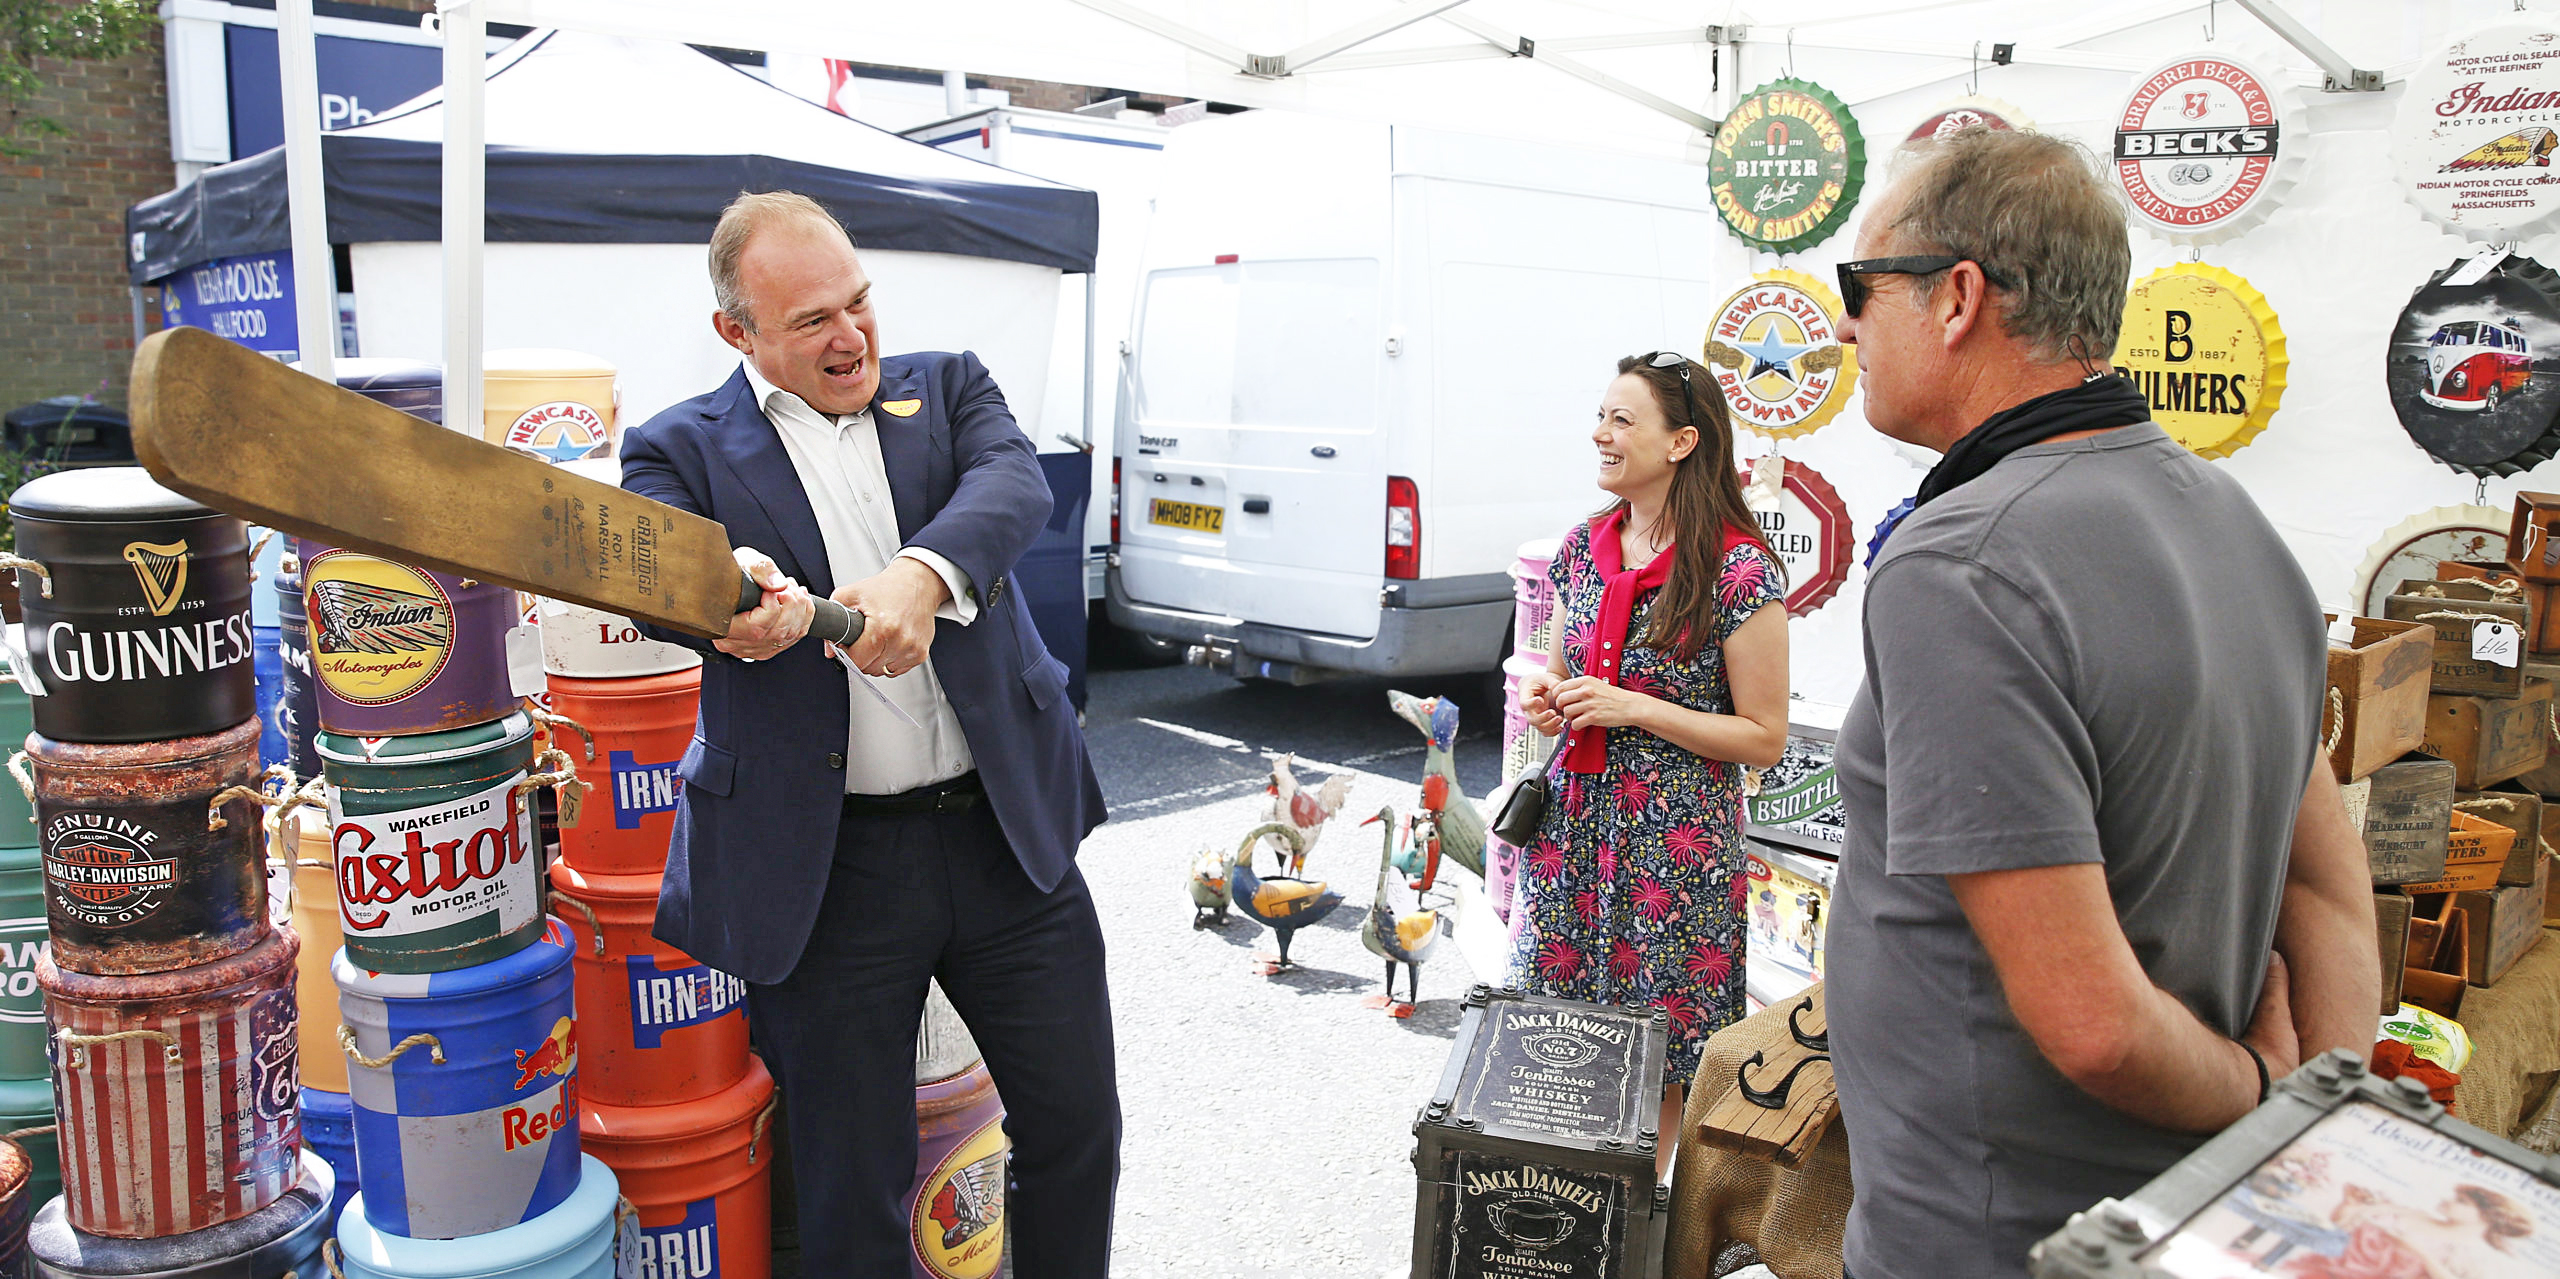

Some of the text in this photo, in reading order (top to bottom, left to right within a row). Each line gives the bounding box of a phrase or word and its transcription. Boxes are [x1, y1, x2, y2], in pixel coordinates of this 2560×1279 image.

[2447, 57, 2480, 67] MOTOR
[2483, 54, 2510, 64] CYCLE
[2513, 53, 2528, 61] OIL
[2466, 62, 2543, 75] AT THE REFINERY
[2124, 63, 2197, 128] BRAUEREI
[2435, 82, 2560, 117] Indian
[321, 93, 384, 130] Ph
[1714, 94, 1844, 159] JOHN SMITH'S
[2123, 127, 2268, 156] BECK'S
[1735, 159, 1818, 178] BITTER
[2417, 181, 2450, 189] INDIAN
[2453, 179, 2490, 188] MOTOR
[2493, 178, 2524, 187] CYCLE
[2459, 189, 2528, 198] SPRINGFIELDS
[1712, 180, 1842, 241] JOHN SMITH'S
[2451, 200, 2535, 209] MASSACHUSETTS
[227, 259, 283, 303] HOUSE
[1718, 292, 1829, 343] NEWCASTLE
[2165, 311, 2193, 362] B
[2130, 349, 2227, 359] ESTD 1887
[1718, 373, 1828, 422] BROWN ALE
[511, 406, 604, 444] NEWCASTLE
[1156, 501, 1222, 530] MH08 FYZ
[598, 503, 609, 583] MARSHALL
[612, 533, 622, 563] ROY
[637, 515, 651, 596] GRADIDGE
[181, 600, 205, 611] 1759
[346, 602, 435, 631] Indian
[1529, 604, 1540, 650] BREWDOG
[47, 608, 253, 682] GUINNESS
[2475, 637, 2508, 655] £16
[323, 656, 424, 678] Motorcycles
[618, 768, 673, 810] IRN
[47, 814, 159, 846] GENUINE
[387, 799, 491, 833] WAKEFIELD
[2368, 821, 2434, 832] MARMALADE
[65, 846, 123, 863] MOTOR
[334, 785, 528, 930] Castrol
[2373, 839, 2427, 851] MERCURY
[2385, 852, 2409, 864] TEA
[47, 860, 171, 884] HARLEY-DAVIDSON
[73, 887, 127, 899] CYCLES
[138, 883, 173, 892] MARK
[411, 879, 508, 916] MOTOR OIL
[56, 895, 161, 924] MOTOR OIL
[637, 974, 697, 1025] IRN
[1506, 1012, 1627, 1044] JACK DANIEL'S
[1564, 1028, 1583, 1038] TIME
[2385, 1023, 2432, 1040] Dettol
[271, 1052, 299, 1106] 66
[1510, 1065, 1596, 1088] Tennessee
[1508, 1085, 1593, 1105] WHISKEY
[1538, 1098, 1550, 1106] AND
[1550, 1100, 1574, 1110] BOTTLED
[502, 1082, 567, 1153] Red
[1490, 1100, 1607, 1123] JACK DANIEL DISTILLERY
[1466, 1165, 1605, 1214] JACK DANIEL'S
[1512, 1190, 1554, 1205] OLD TIME
[1481, 1245, 1573, 1274] Tennessee
[1514, 1248, 1537, 1257] QUALITY
[1498, 1265, 1525, 1275] SOUR
[1528, 1269, 1556, 1279] MASH
